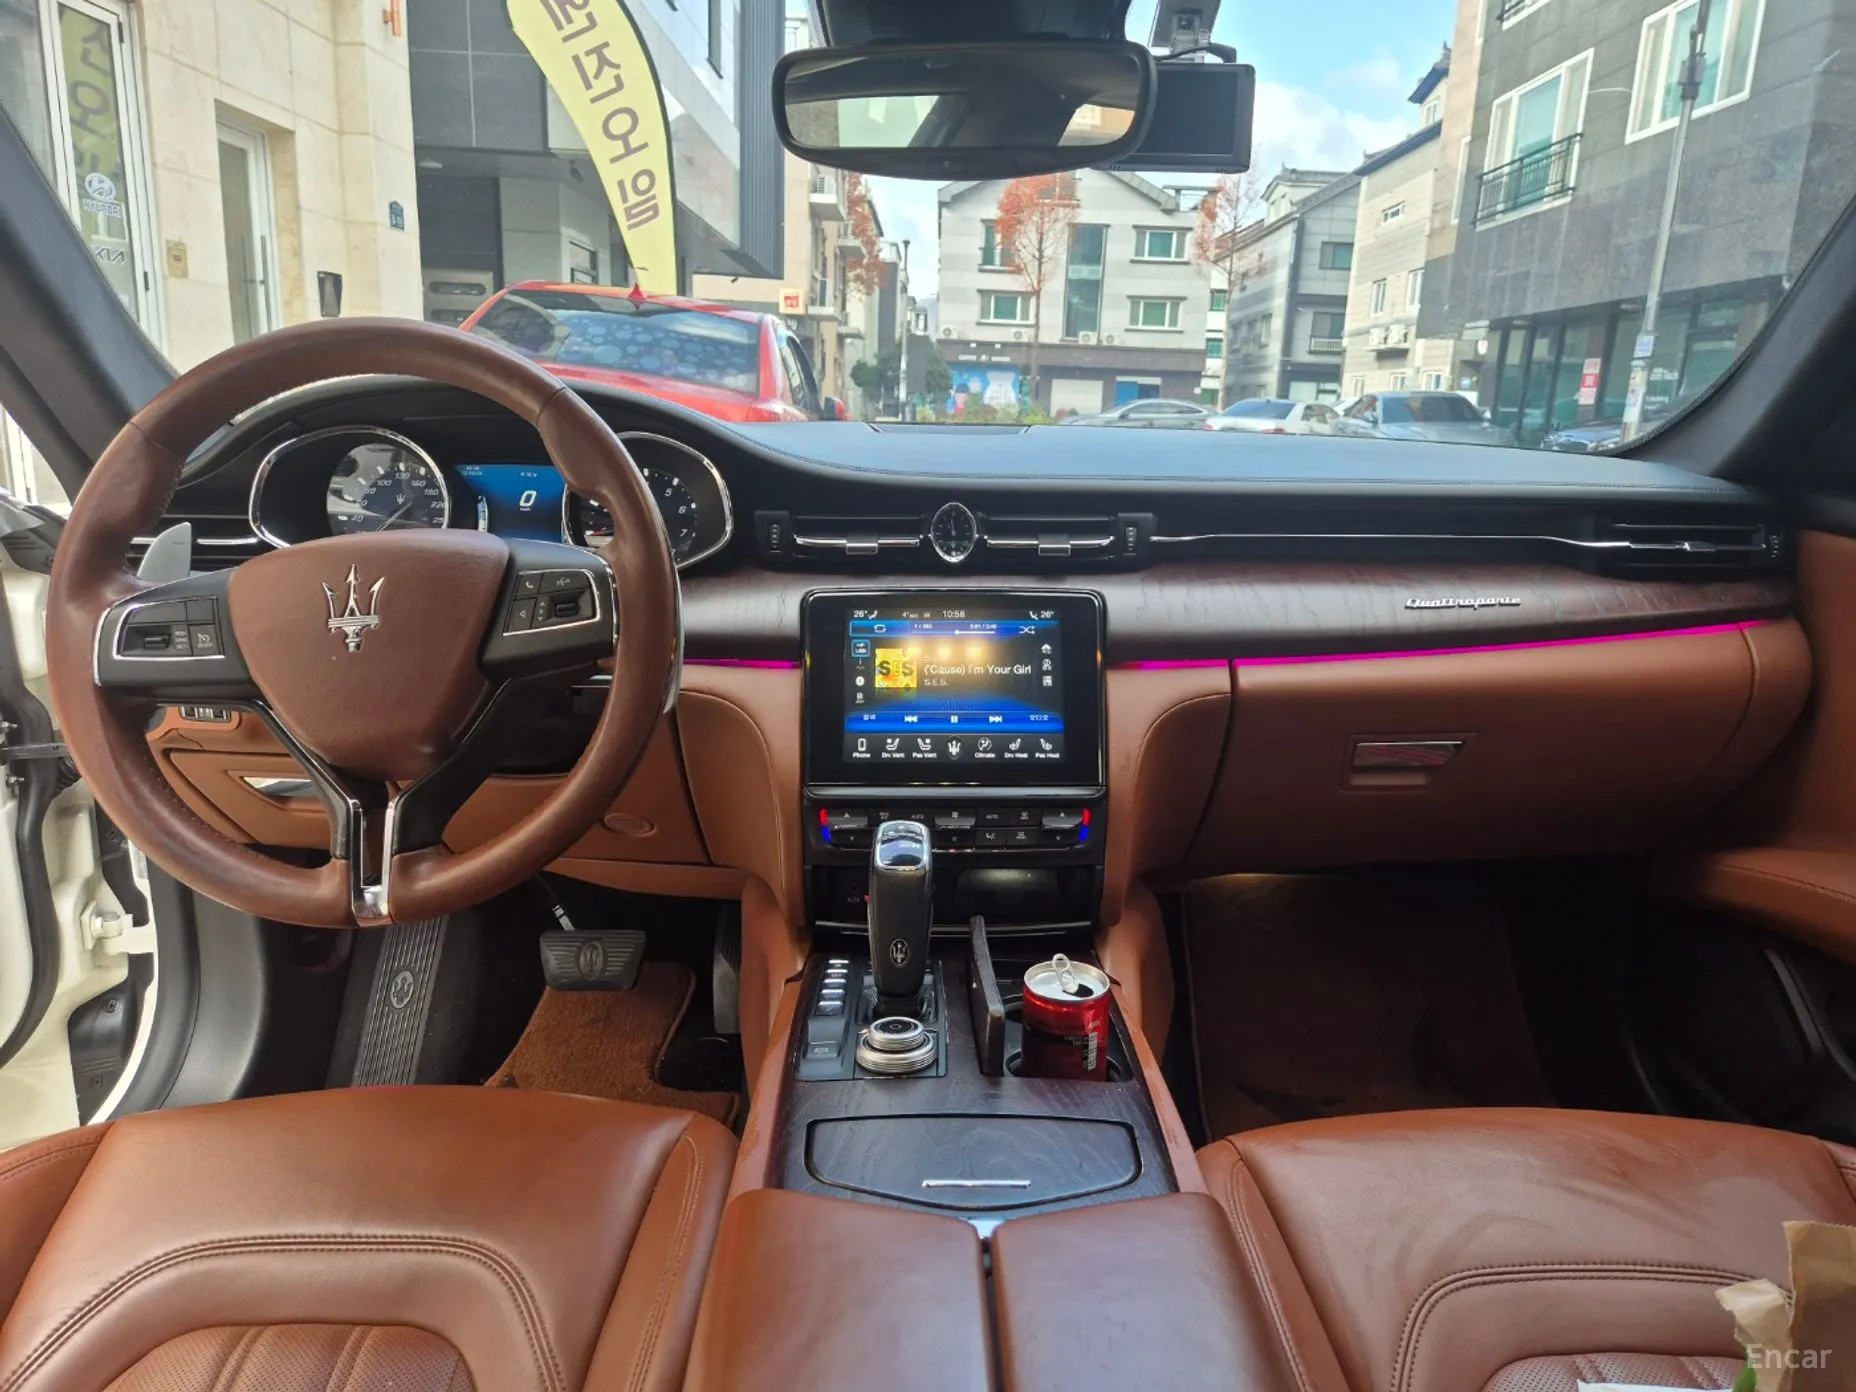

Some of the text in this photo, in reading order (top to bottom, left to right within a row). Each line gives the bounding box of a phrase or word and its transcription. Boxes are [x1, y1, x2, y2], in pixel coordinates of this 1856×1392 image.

[664, 487, 673, 497] 5
[519, 489, 537, 507] 0
[678, 505, 687, 514] 6
[680, 528, 688, 537] 7
[1404, 596, 1521, 609] Quattroporte
[942, 610, 965, 618] 10:58
[986, 665, 1011, 674] Your
[1012, 664, 1032, 675] Girl
